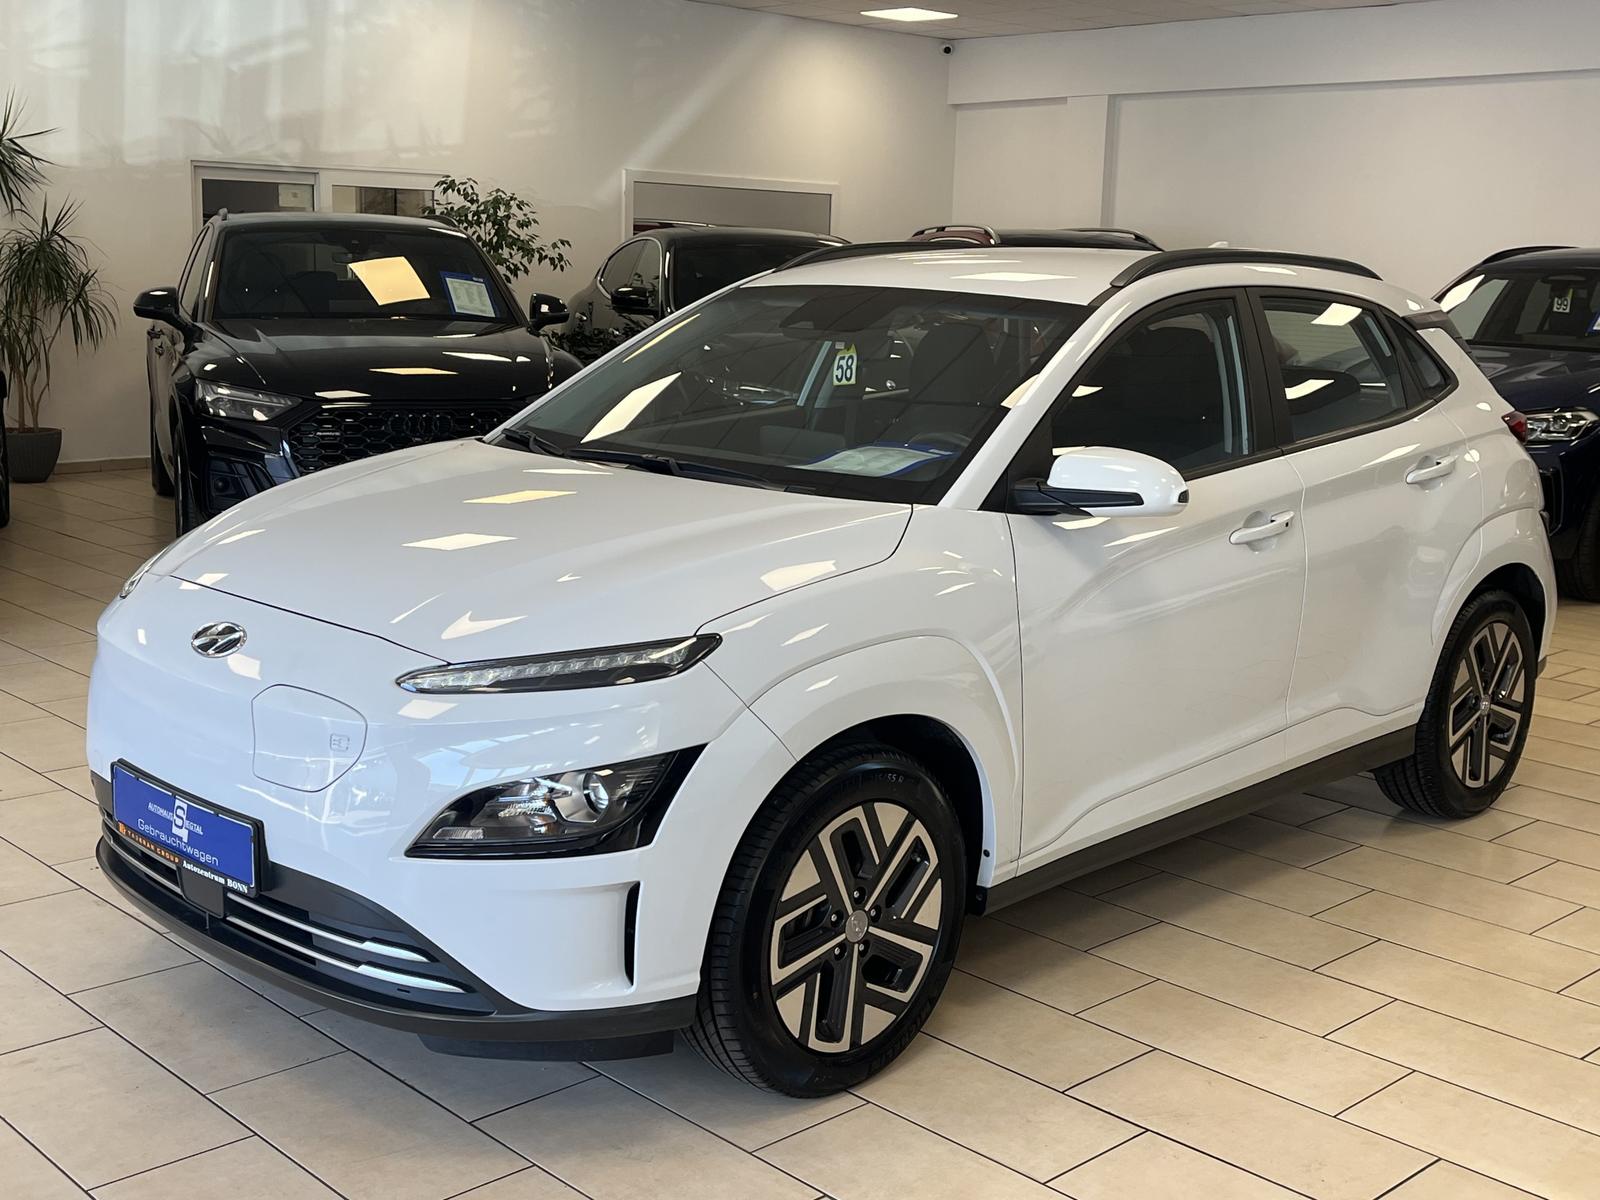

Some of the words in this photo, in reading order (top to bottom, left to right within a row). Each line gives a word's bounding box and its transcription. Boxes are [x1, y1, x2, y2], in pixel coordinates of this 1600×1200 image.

[1555, 298, 1569, 311] 99
[835, 354, 854, 383] 58
[137, 818, 219, 867] Gebrauchtwagen
[182, 860, 226, 885] Autozentrum
[226, 878, 248, 894] BONN
